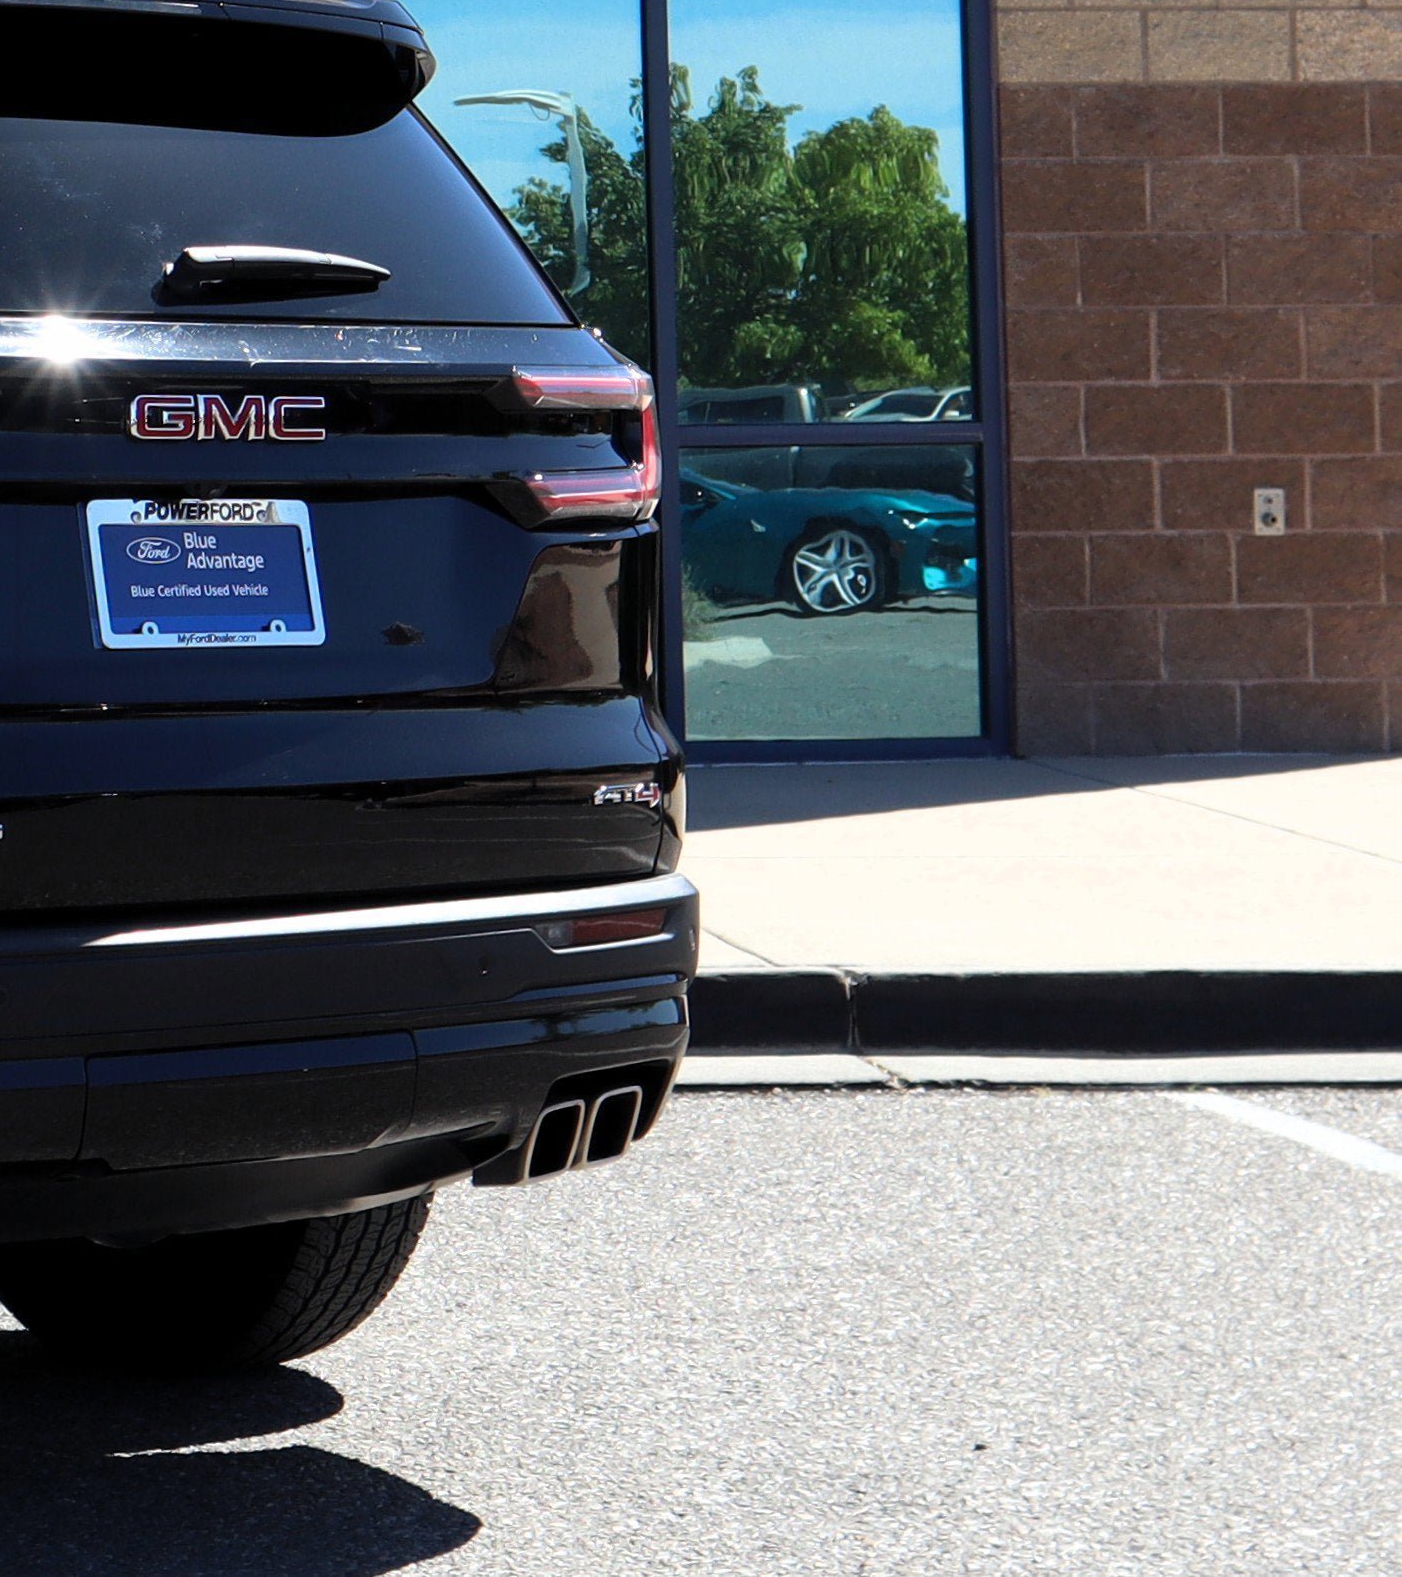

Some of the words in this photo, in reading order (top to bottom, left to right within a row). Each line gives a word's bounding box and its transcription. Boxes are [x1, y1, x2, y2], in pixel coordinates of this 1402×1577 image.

[130, 394, 326, 441] GMC
[137, 540, 171, 559] Ford
[183, 532, 217, 549] Blue
[187, 552, 264, 572] Advantage
[131, 585, 155, 597] Blue
[157, 584, 201, 597] Certified
[203, 584, 229, 596] Used
[231, 583, 269, 596] Vehicle
